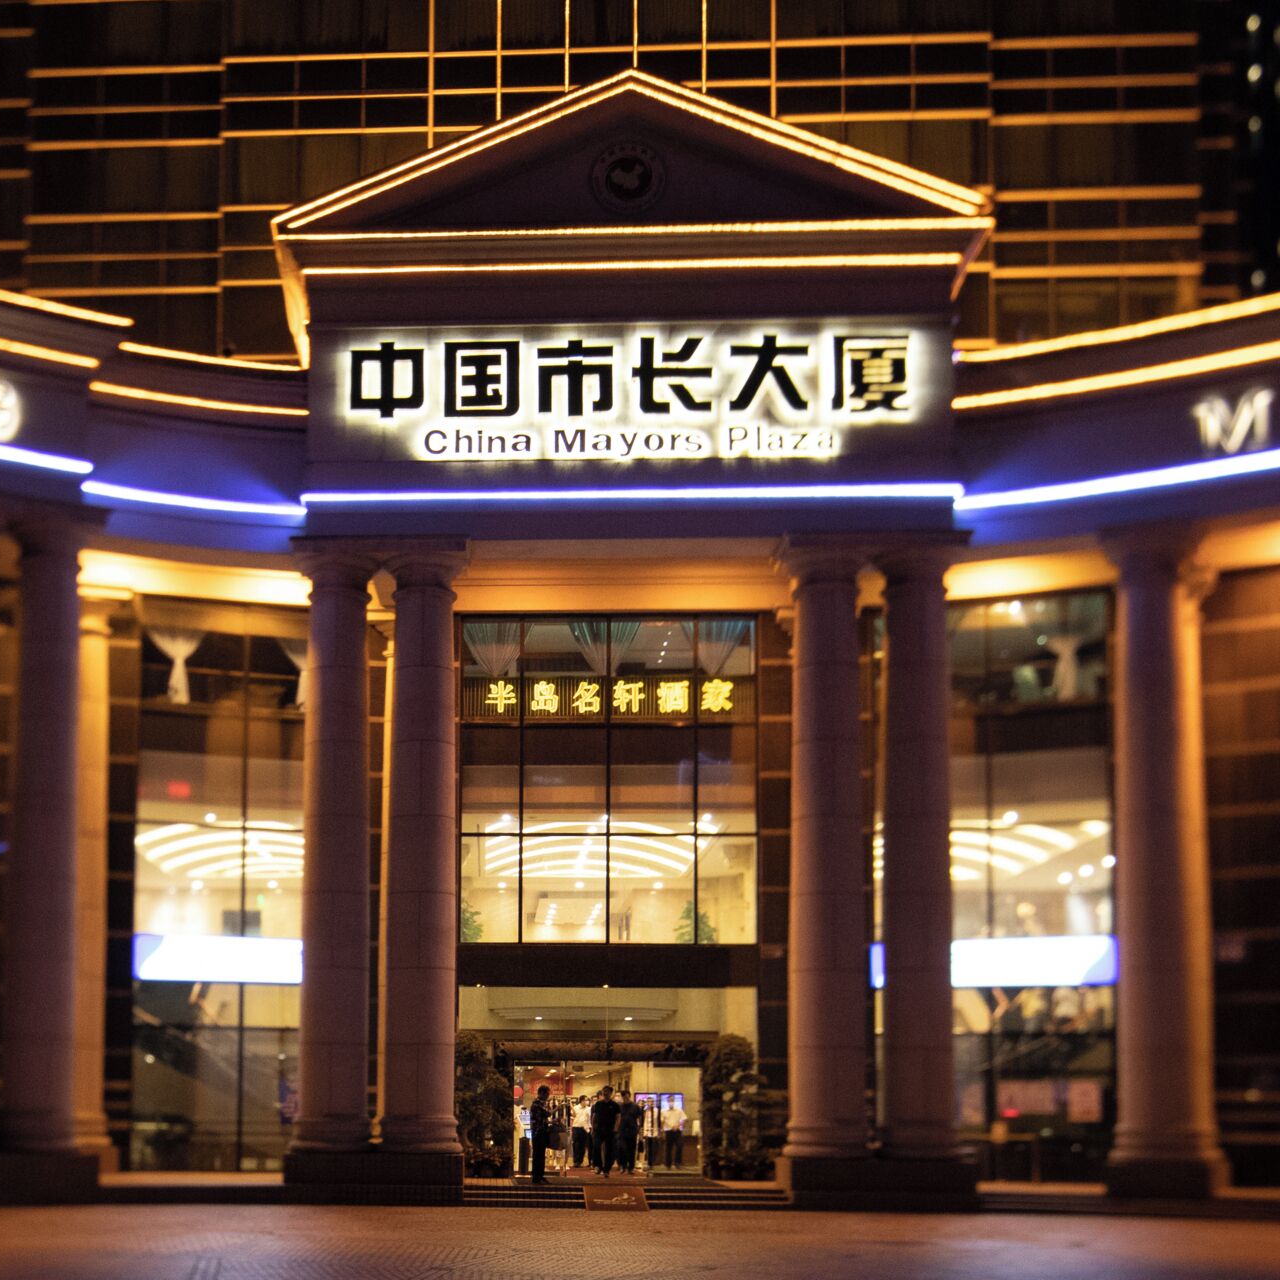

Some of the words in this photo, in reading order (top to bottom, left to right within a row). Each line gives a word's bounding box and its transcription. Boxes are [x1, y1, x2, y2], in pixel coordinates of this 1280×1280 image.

[350, 333, 911, 418] 中国市长大厦
[423, 428, 532, 455] China
[553, 427, 703, 457] Mayors
[727, 425, 834, 452] Plaza
[484, 678, 734, 714] 半岛名轩酒家
